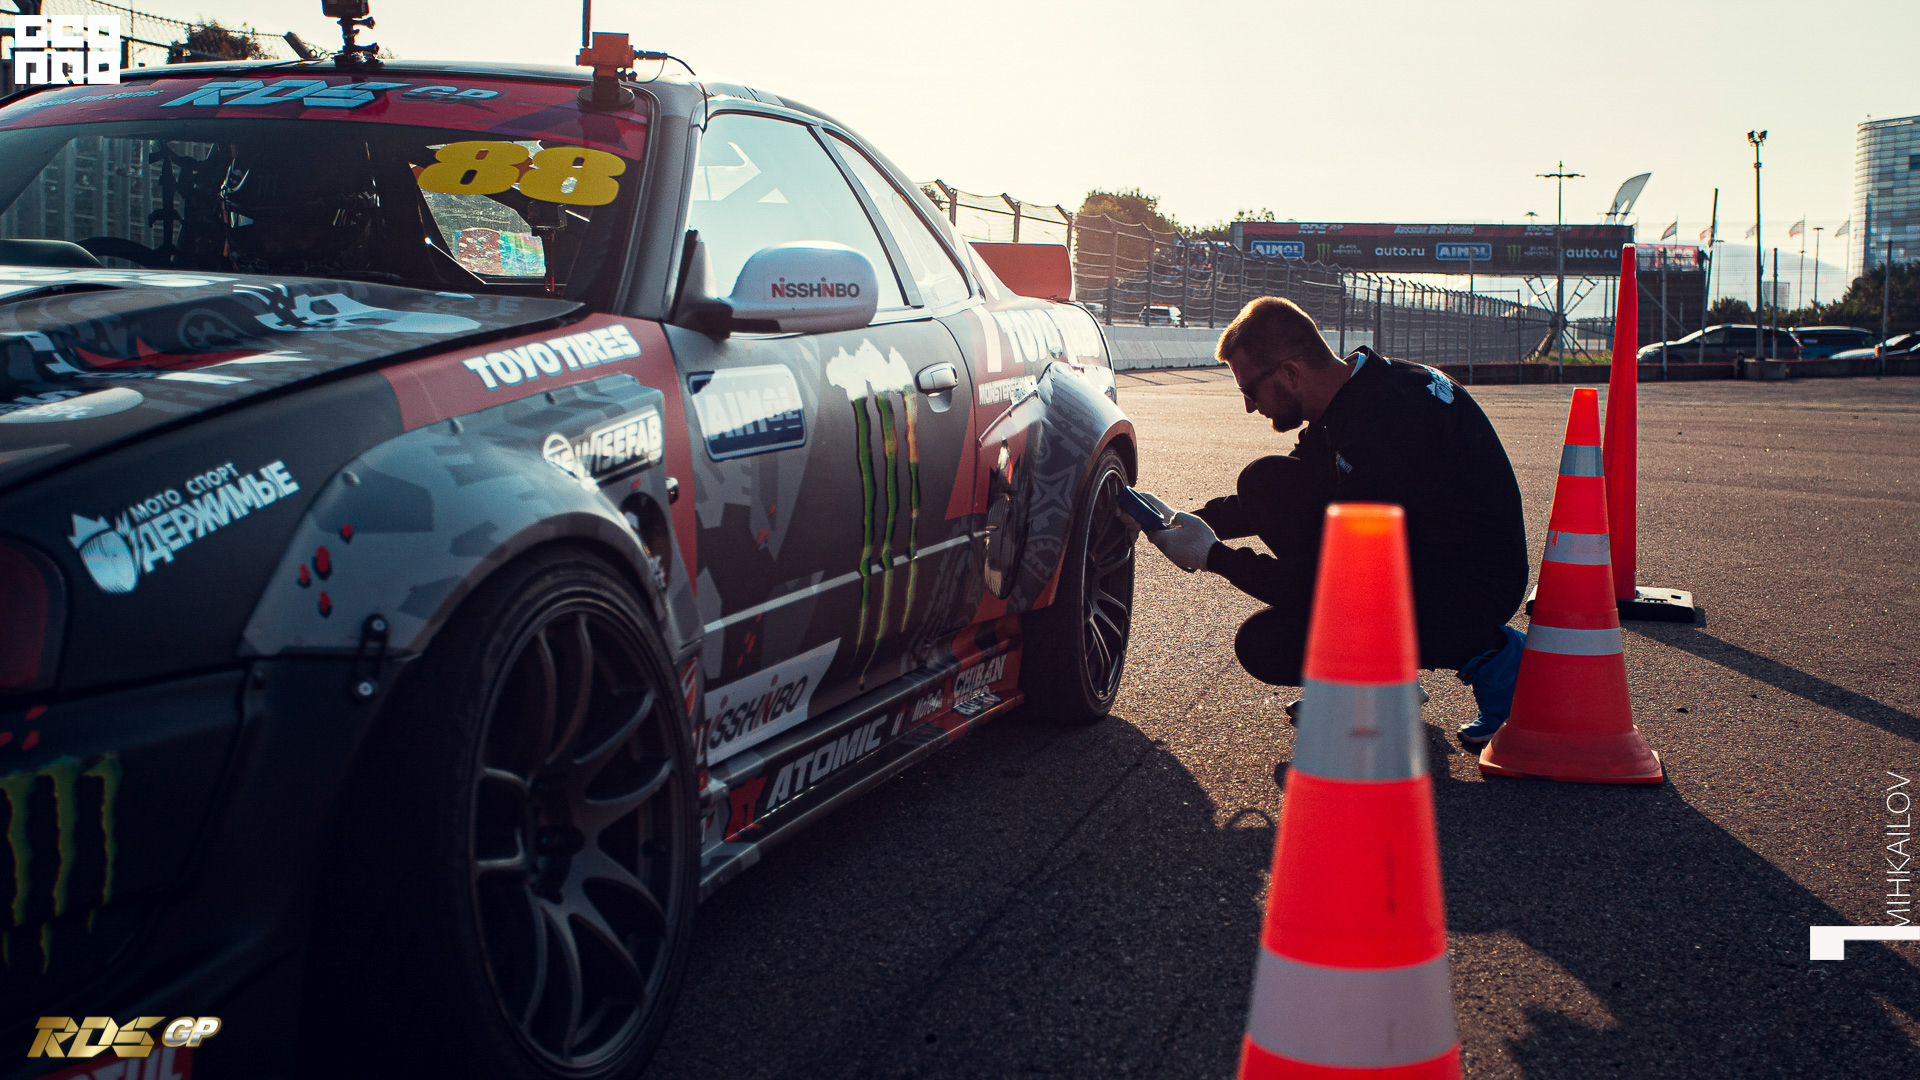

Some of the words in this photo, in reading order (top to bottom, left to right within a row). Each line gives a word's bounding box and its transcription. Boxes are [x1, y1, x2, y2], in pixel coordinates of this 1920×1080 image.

[160, 80, 413, 108] RDS
[417, 140, 627, 206] 88
[1254, 244, 1302, 255] AIMOL
[1374, 246, 1425, 257] auto.ru
[1438, 246, 1489, 257] AIMOL
[1565, 247, 1618, 259] auto.ru
[991, 309, 1063, 363] TOYO
[462, 341, 562, 391] TOYO
[546, 324, 641, 371] TIRES
[129, 488, 182, 523] МОТО
[185, 462, 241, 496] СПОРТ
[766, 714, 888, 809] ATOMIC
